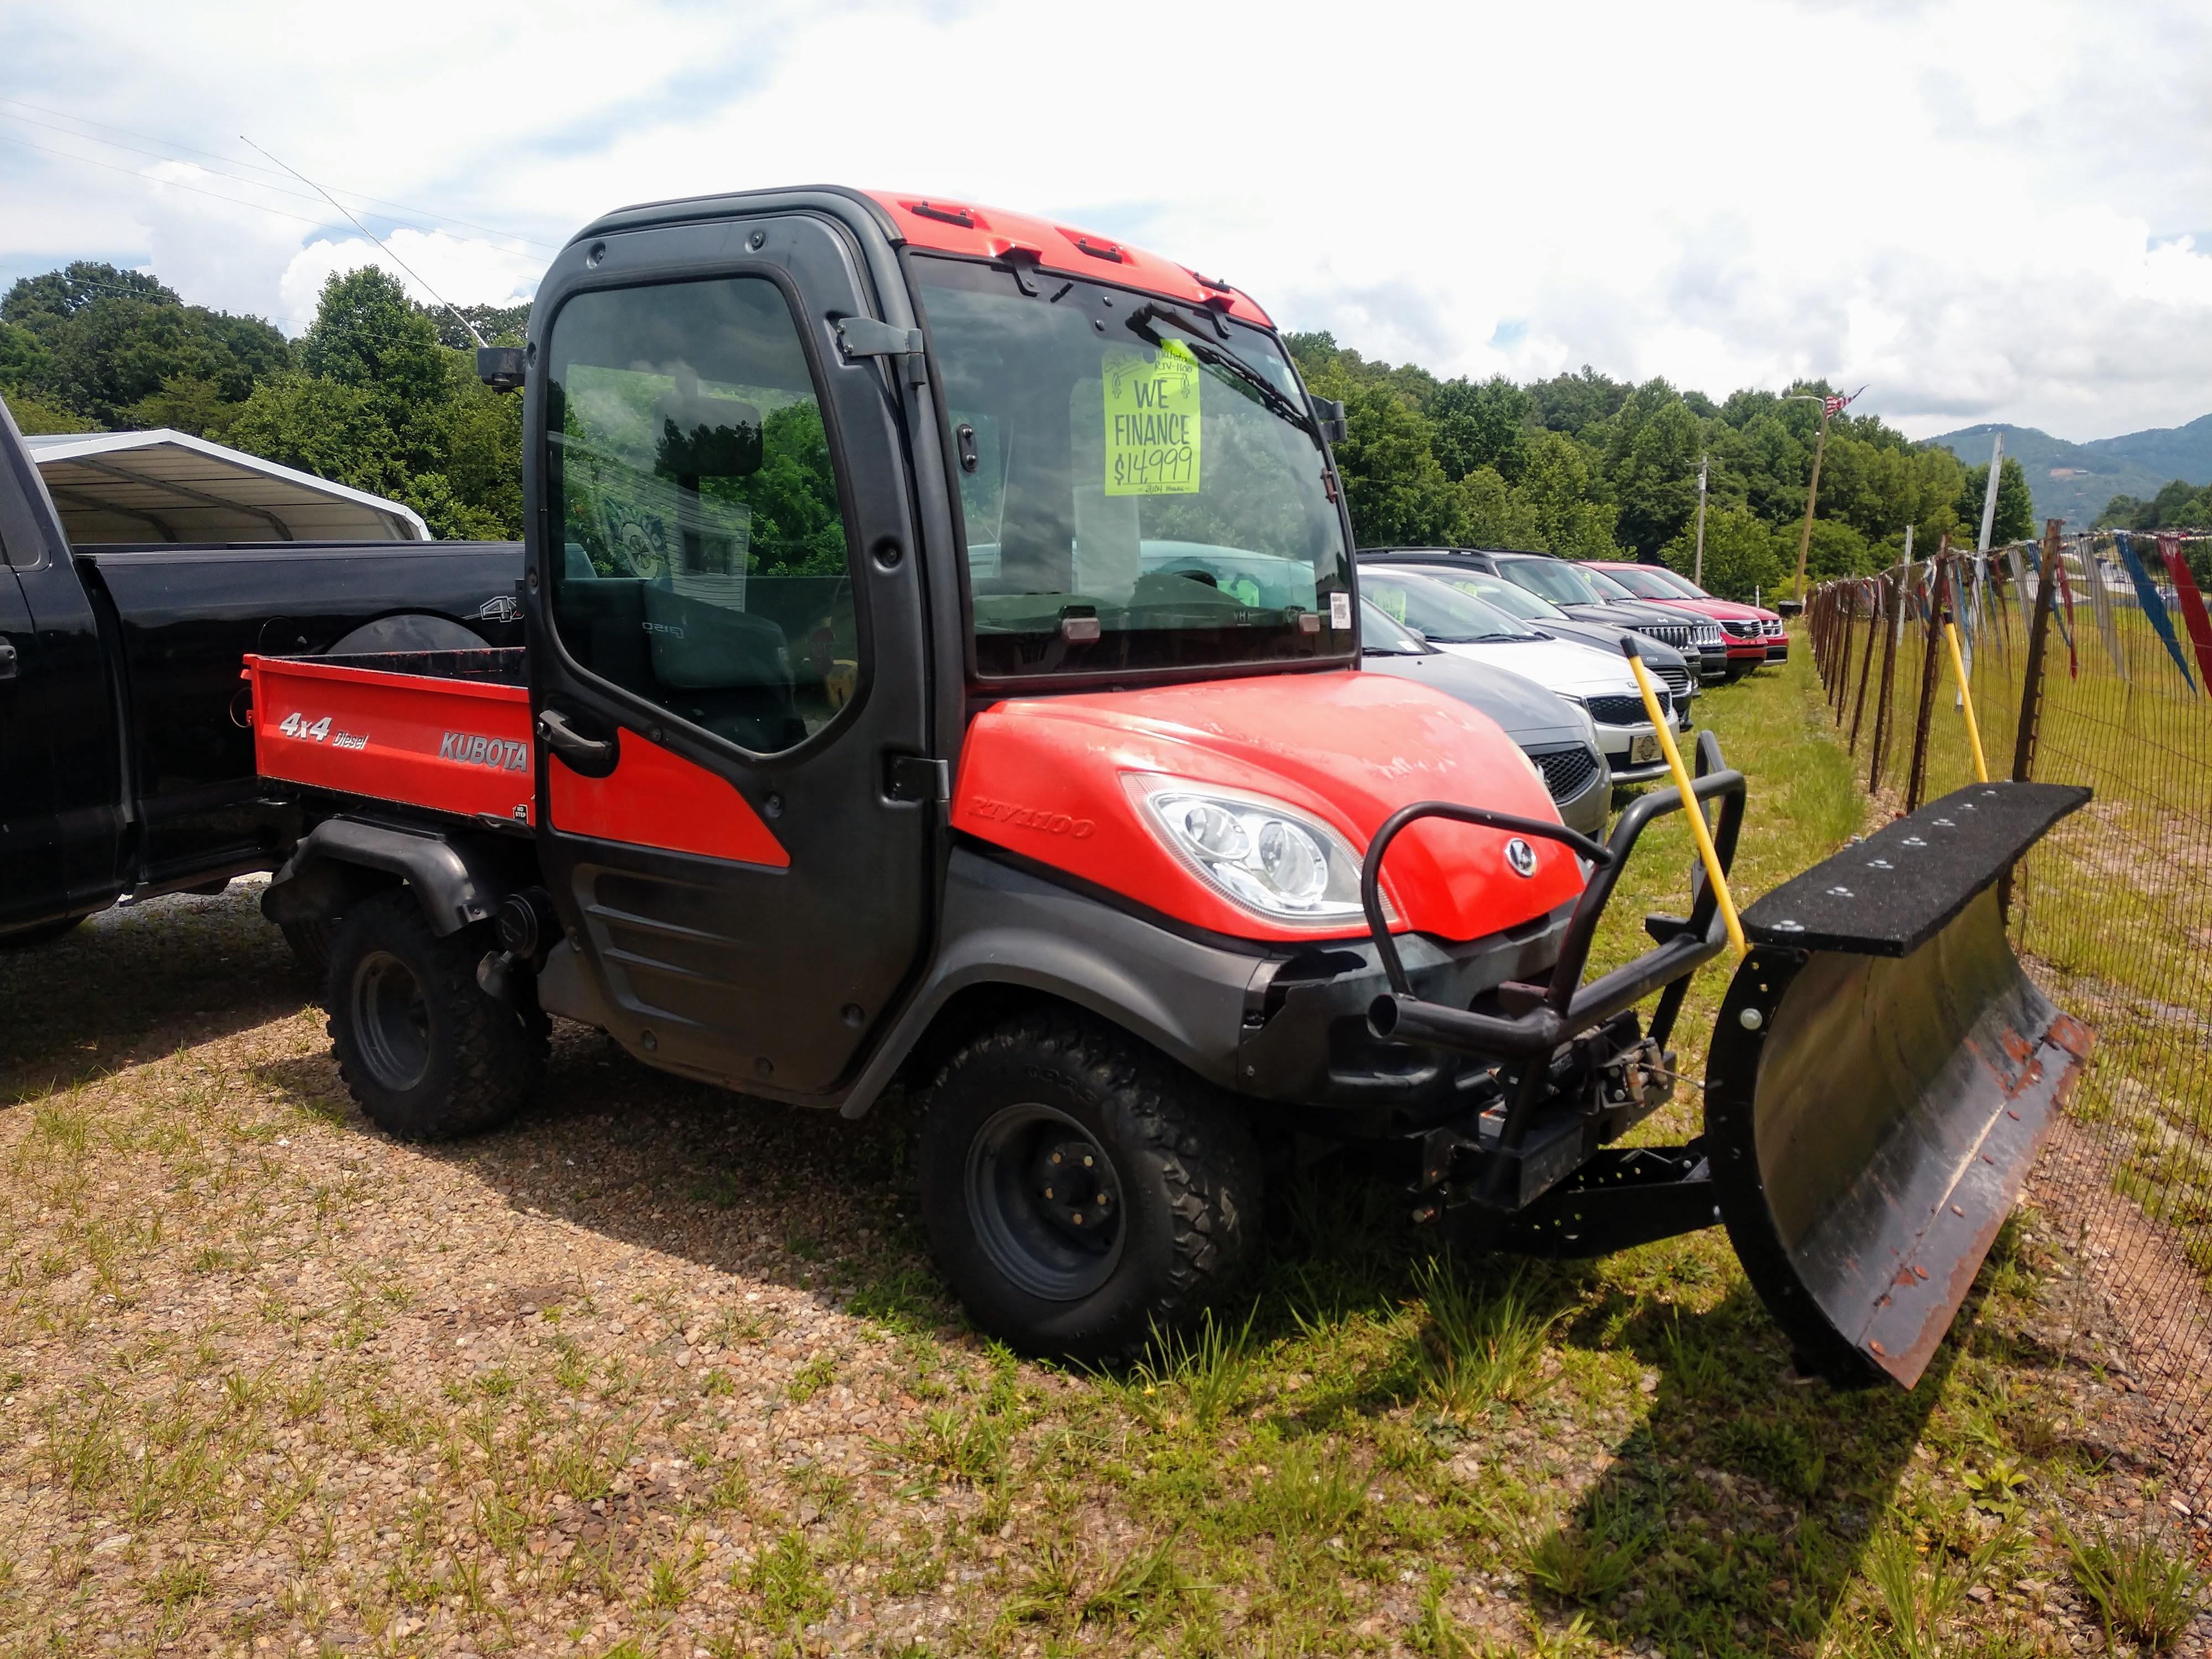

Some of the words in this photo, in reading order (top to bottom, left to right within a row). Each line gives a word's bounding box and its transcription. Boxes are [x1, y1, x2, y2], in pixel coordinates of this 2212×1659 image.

[1134, 379, 1169, 409] WE
[1114, 412, 1191, 446] FINANCE
[1114, 446, 1192, 486] $14,999
[279, 712, 332, 742] 4x4
[332, 731, 369, 751] Diesel
[439, 732, 528, 773] KUBOTA
